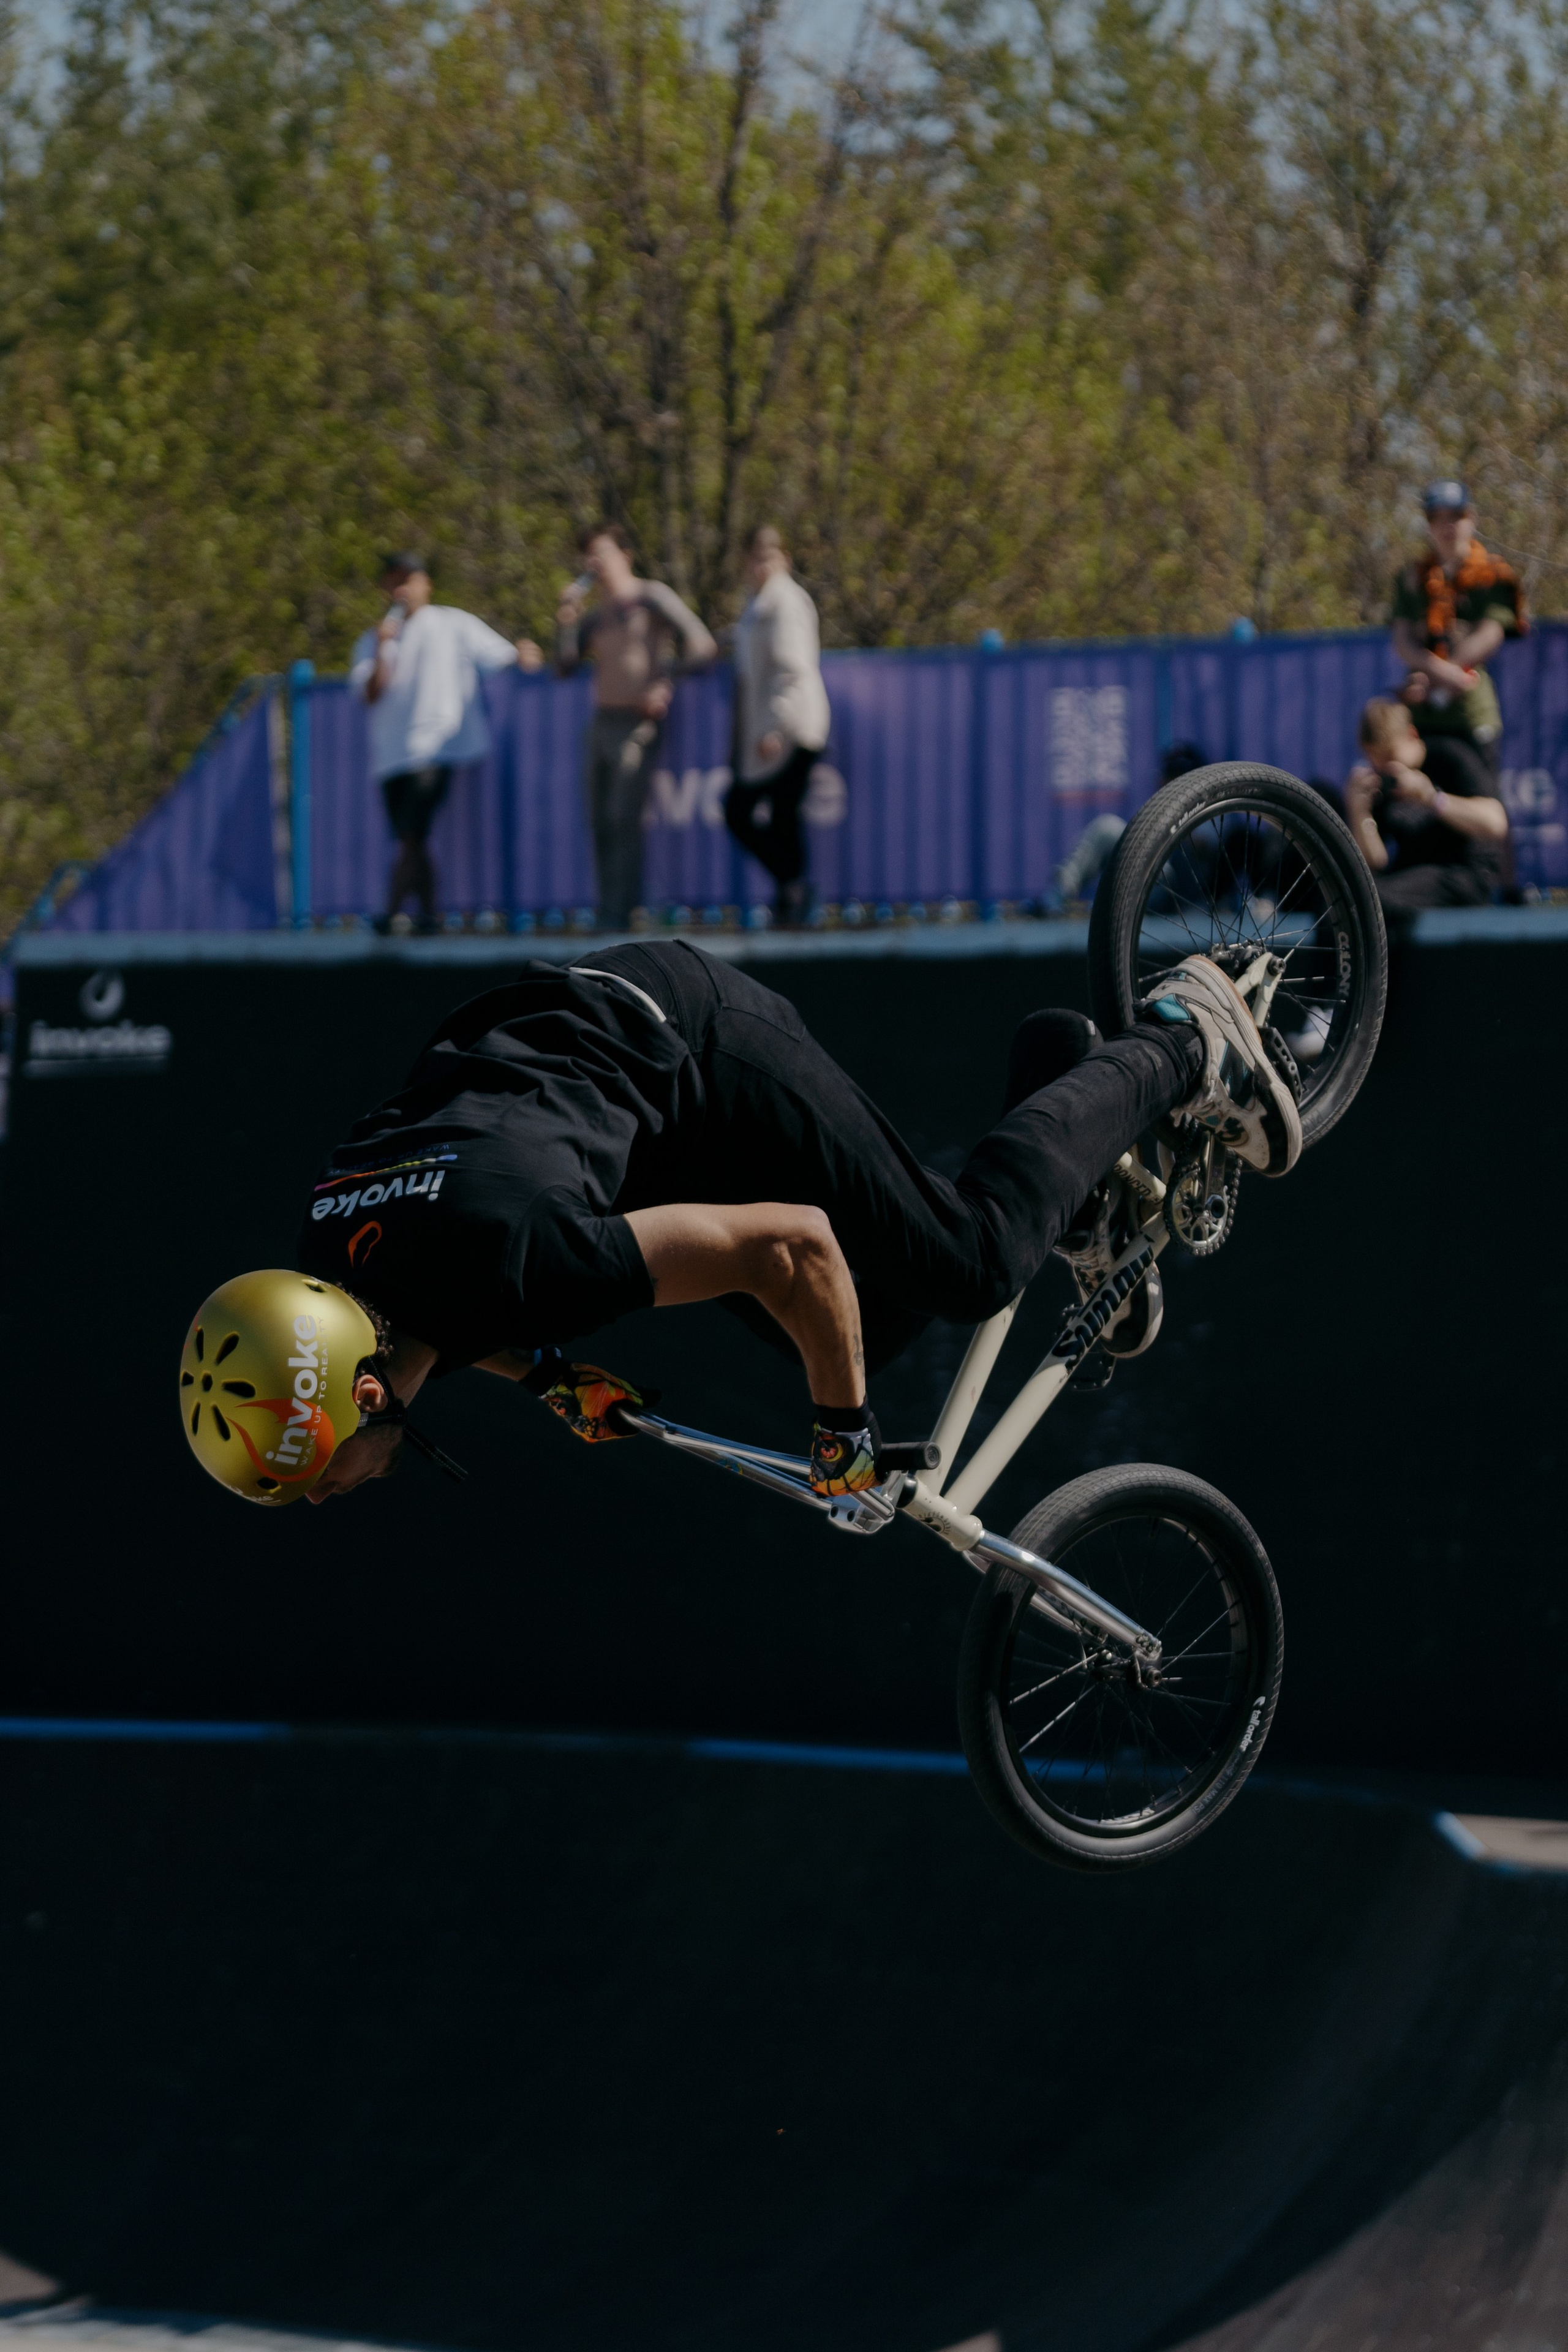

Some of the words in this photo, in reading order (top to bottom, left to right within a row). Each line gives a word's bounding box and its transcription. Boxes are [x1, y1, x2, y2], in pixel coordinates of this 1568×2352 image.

[1338, 931, 1352, 997] COLONY
[311, 1169, 446, 1221] invoke
[266, 1314, 318, 1466] invoke
[300, 1427, 318, 1466] WAKE
[314, 1404, 322, 1424] UP
[318, 1380, 327, 1400] TO
[1204, 1789, 1219, 1804] MAX
